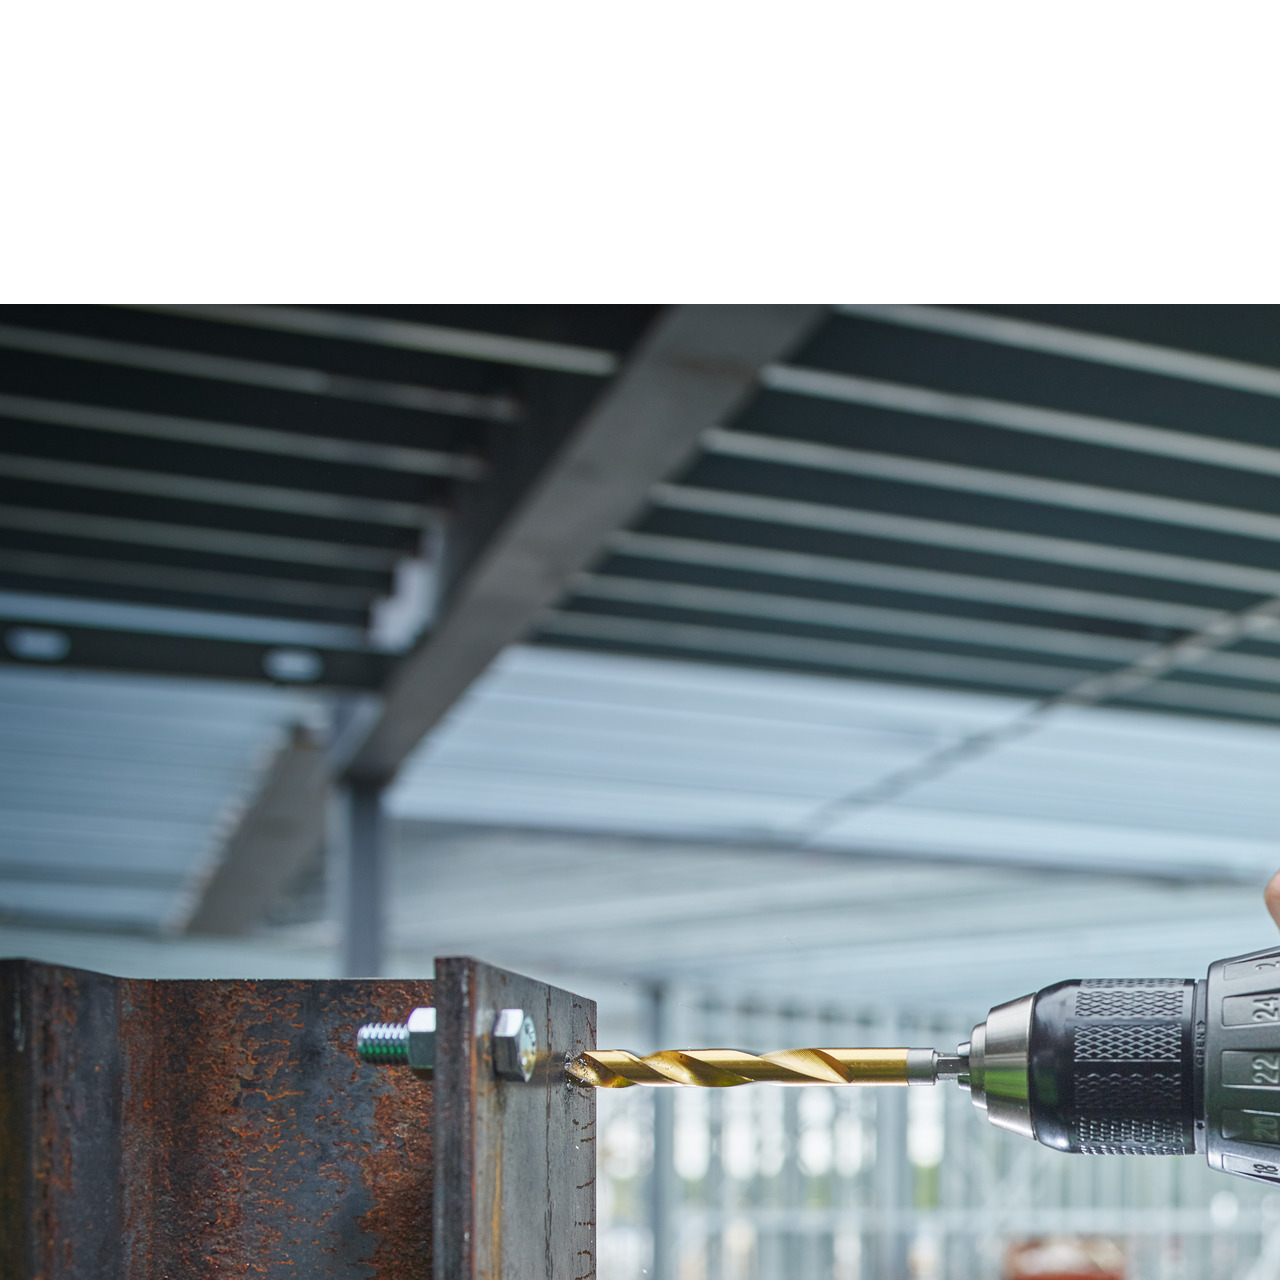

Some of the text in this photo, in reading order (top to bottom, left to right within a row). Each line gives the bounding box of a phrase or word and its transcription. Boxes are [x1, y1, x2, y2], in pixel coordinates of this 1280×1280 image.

[1253, 996, 1279, 1022] 24
[1252, 1054, 1279, 1084] 22
[1253, 1116, 1278, 1139] 20
[1253, 1163, 1279, 1175] 18
